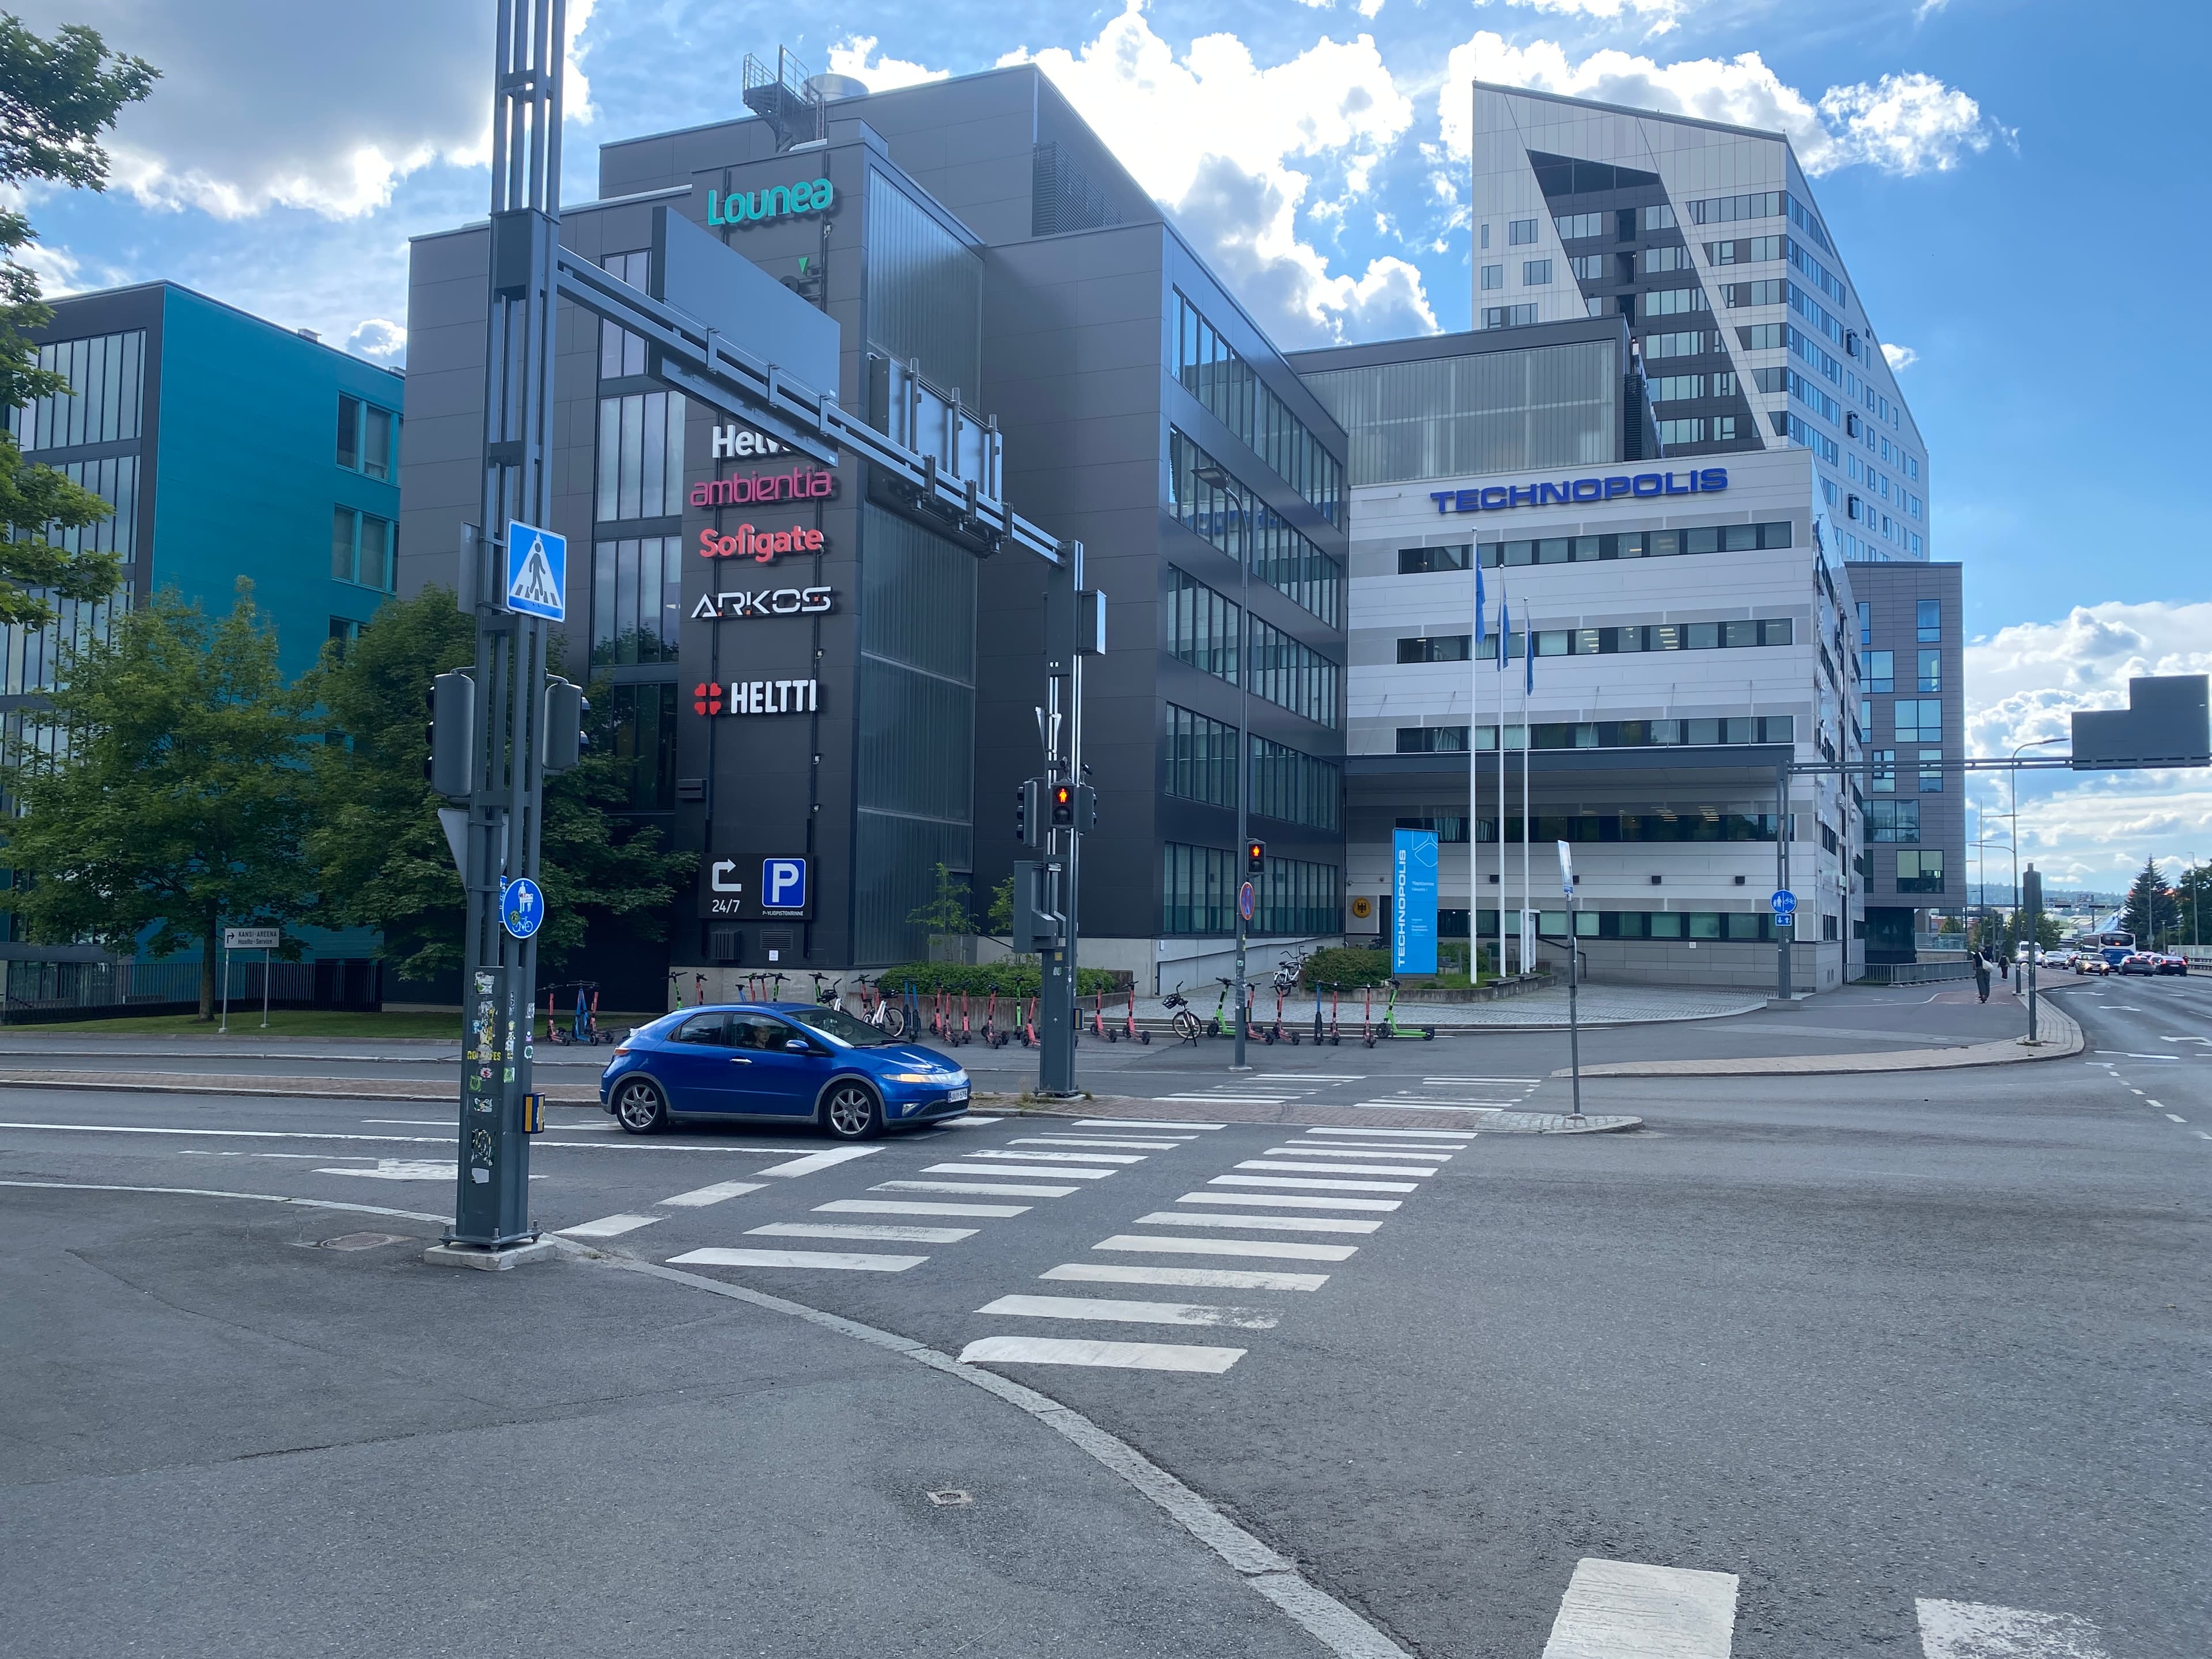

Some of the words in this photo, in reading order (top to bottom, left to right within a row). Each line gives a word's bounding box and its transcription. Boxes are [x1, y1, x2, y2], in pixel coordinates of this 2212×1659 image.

[707, 178, 834, 225] Lounea
[690, 465, 832, 507] ambientia
[1430, 467, 1728, 513] TECHNOPOLIS
[699, 523, 825, 563] Sofigate
[691, 586, 832, 619] ARKOS
[731, 679, 817, 714] HELTTI
[772, 863, 800, 903] P
[712, 899, 740, 914] 24/7
[1397, 849, 1407, 968] TECHNOPOLIS
